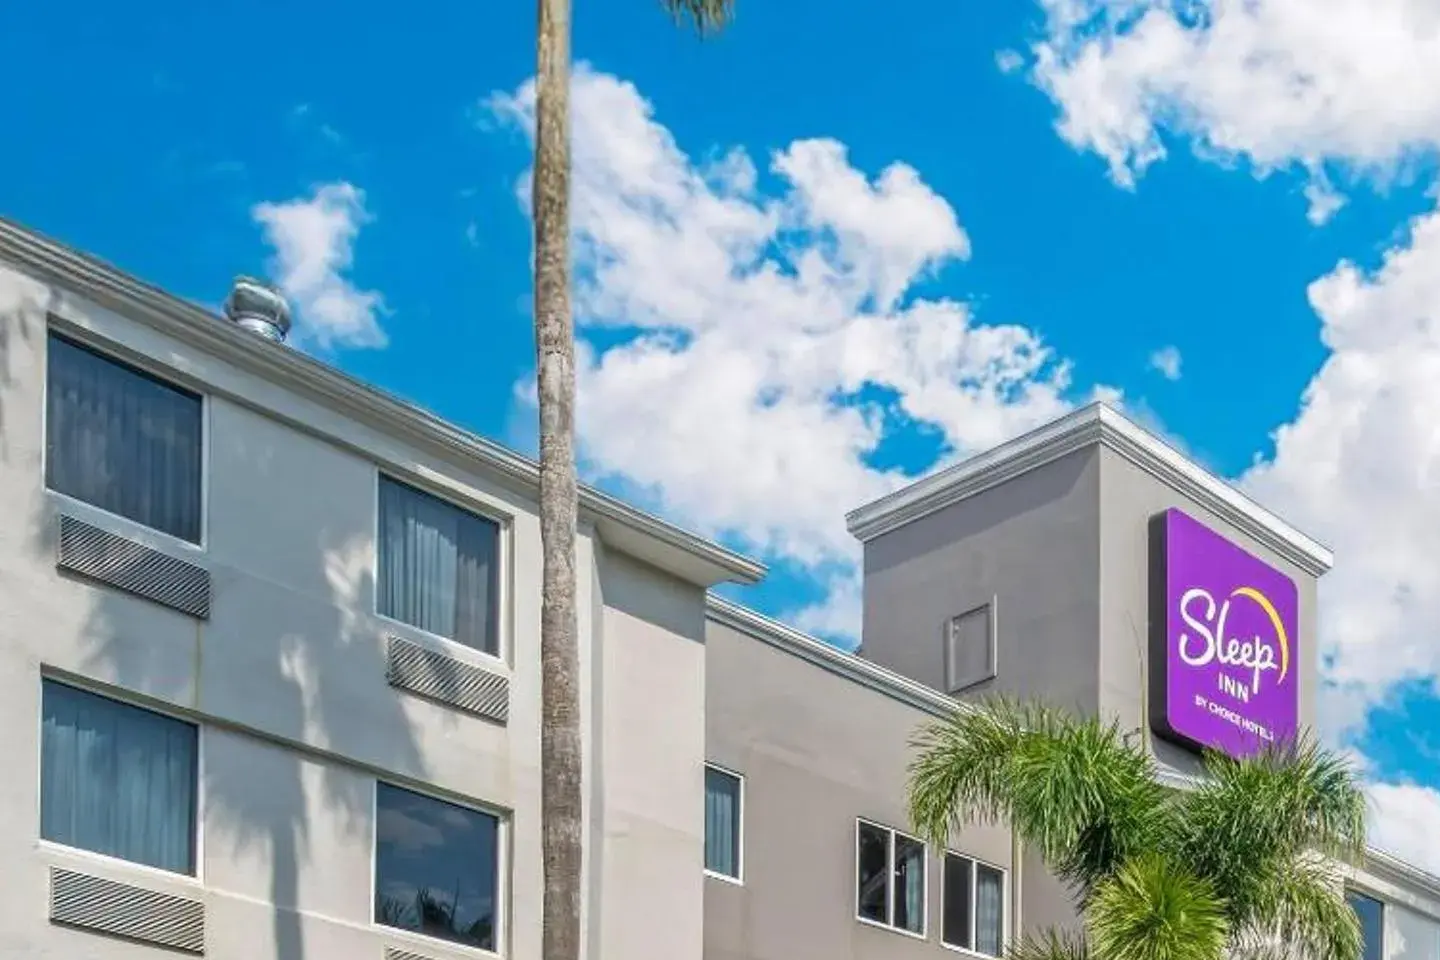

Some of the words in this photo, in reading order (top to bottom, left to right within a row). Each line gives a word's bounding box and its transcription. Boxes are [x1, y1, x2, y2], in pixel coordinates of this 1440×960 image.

[1179, 588, 1278, 694] Sleep
[1218, 672, 1249, 703] INN
[1195, 694, 1207, 707] BY
[1209, 702, 1242, 726] CHOICE
